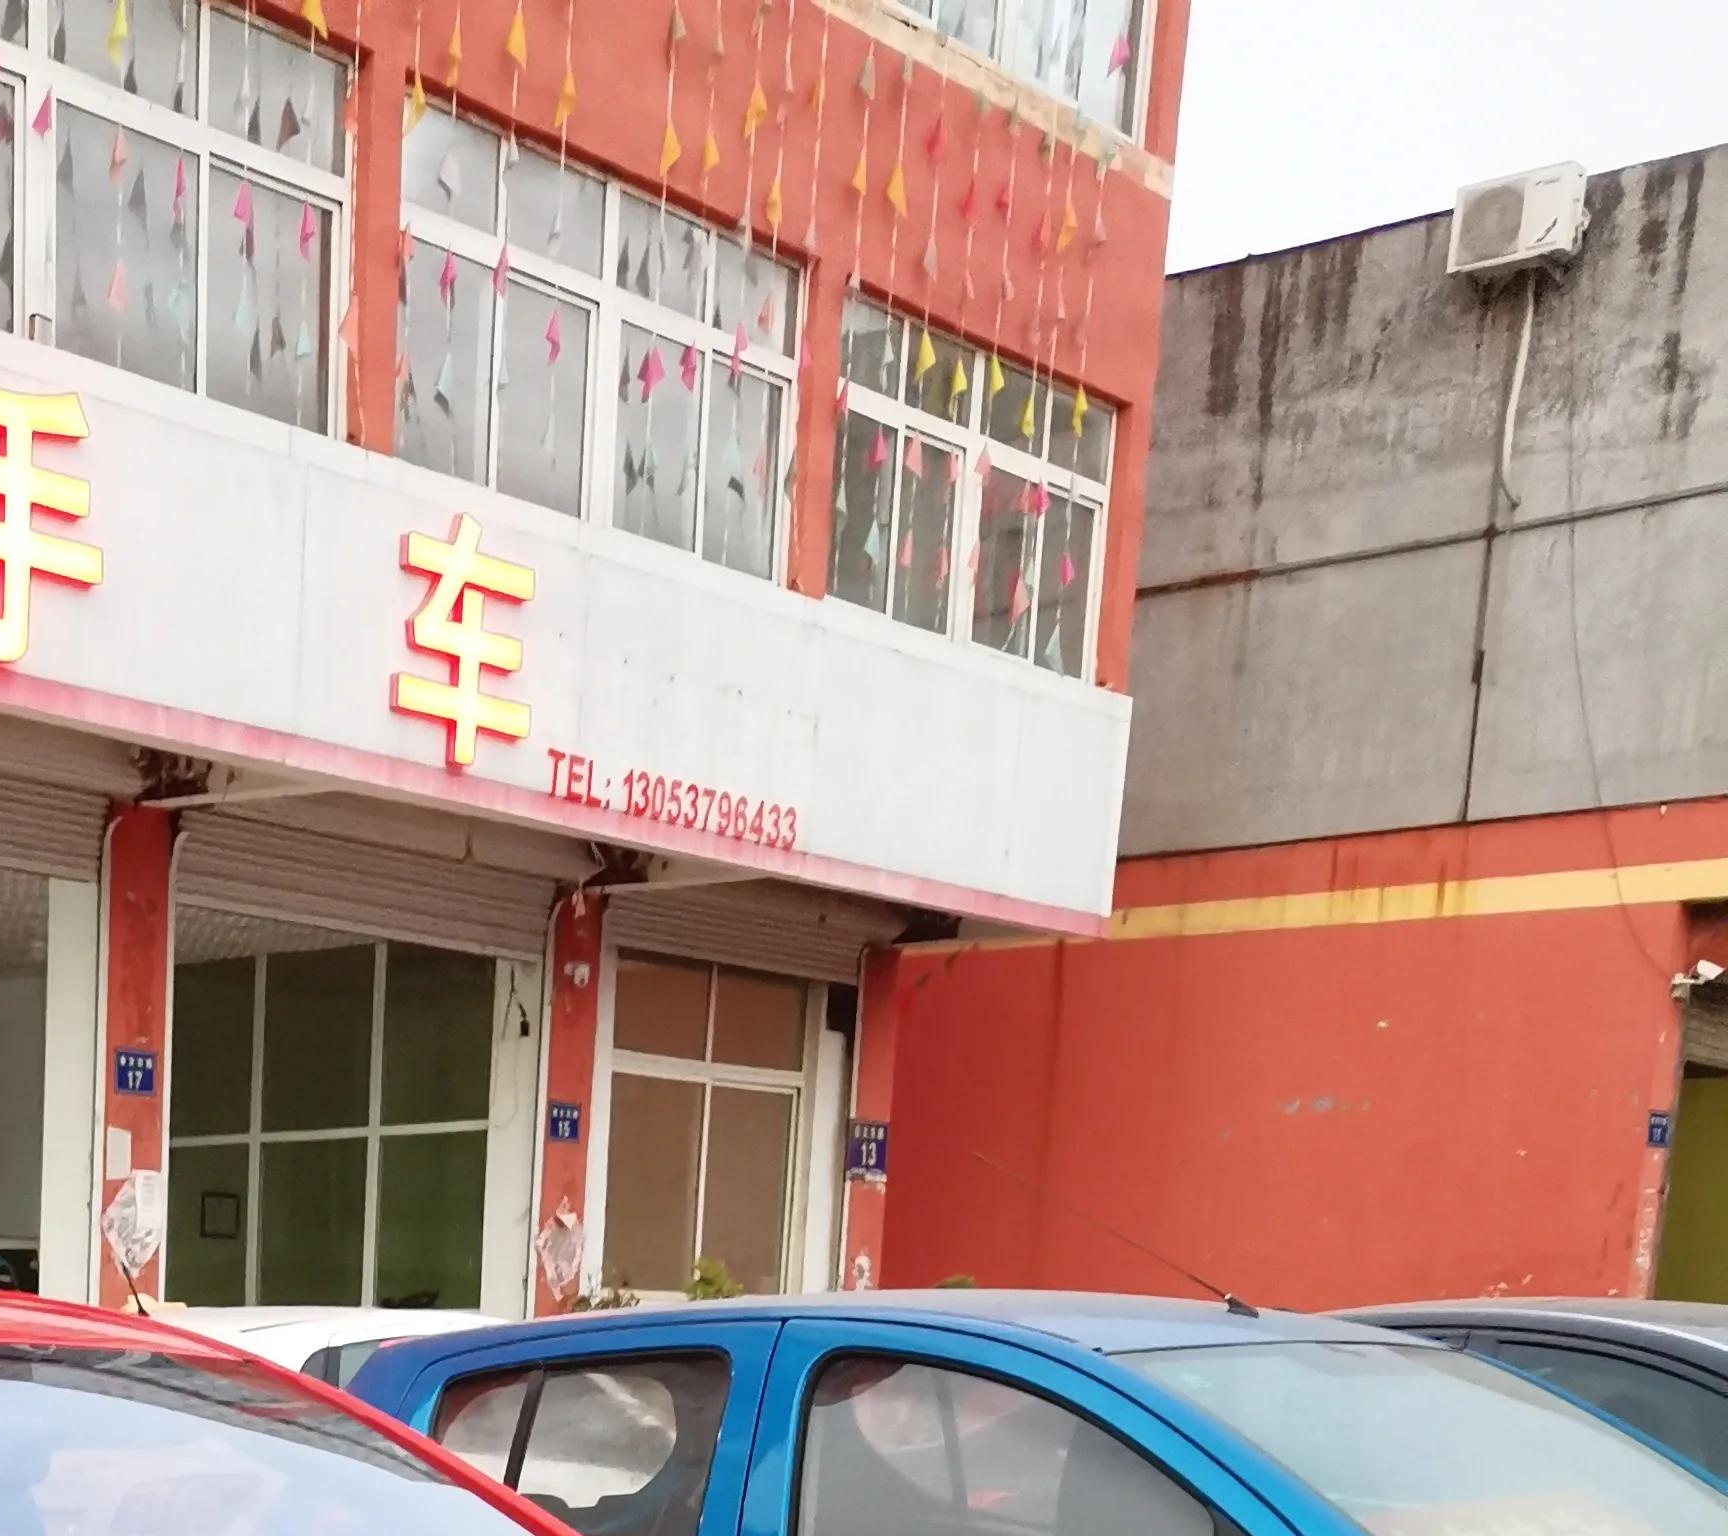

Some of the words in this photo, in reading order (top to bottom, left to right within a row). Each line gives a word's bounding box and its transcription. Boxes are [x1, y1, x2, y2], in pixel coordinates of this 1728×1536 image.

[623, 768, 797, 850] 13053796433
[127, 1071, 143, 1089] 17
[861, 1142, 877, 1166] 13
